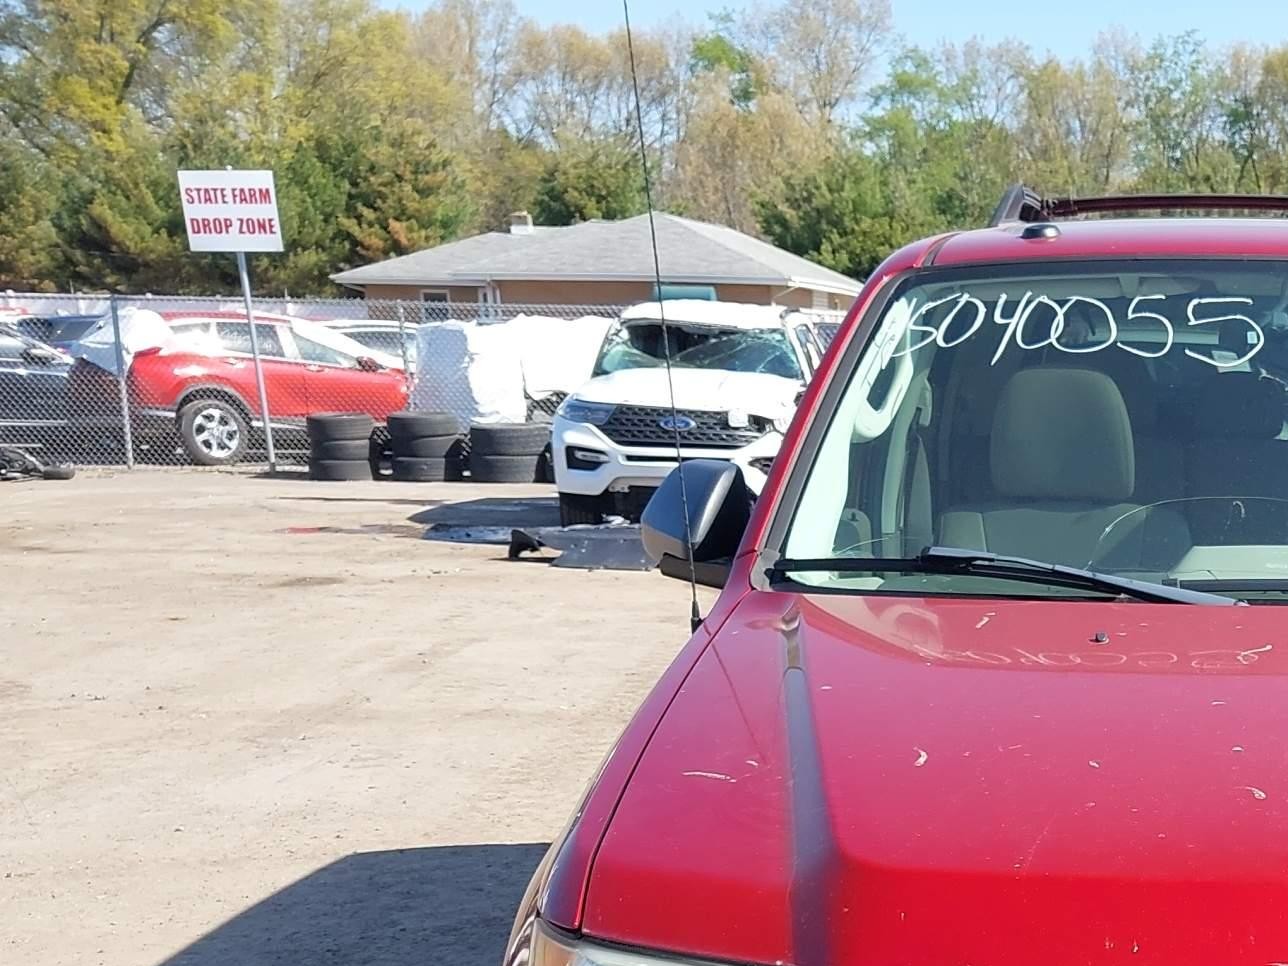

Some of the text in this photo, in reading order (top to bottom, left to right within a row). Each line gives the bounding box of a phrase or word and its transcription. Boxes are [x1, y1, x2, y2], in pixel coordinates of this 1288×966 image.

[184, 187, 272, 205] STATE FARM
[190, 217, 277, 235] DROP ZONE
